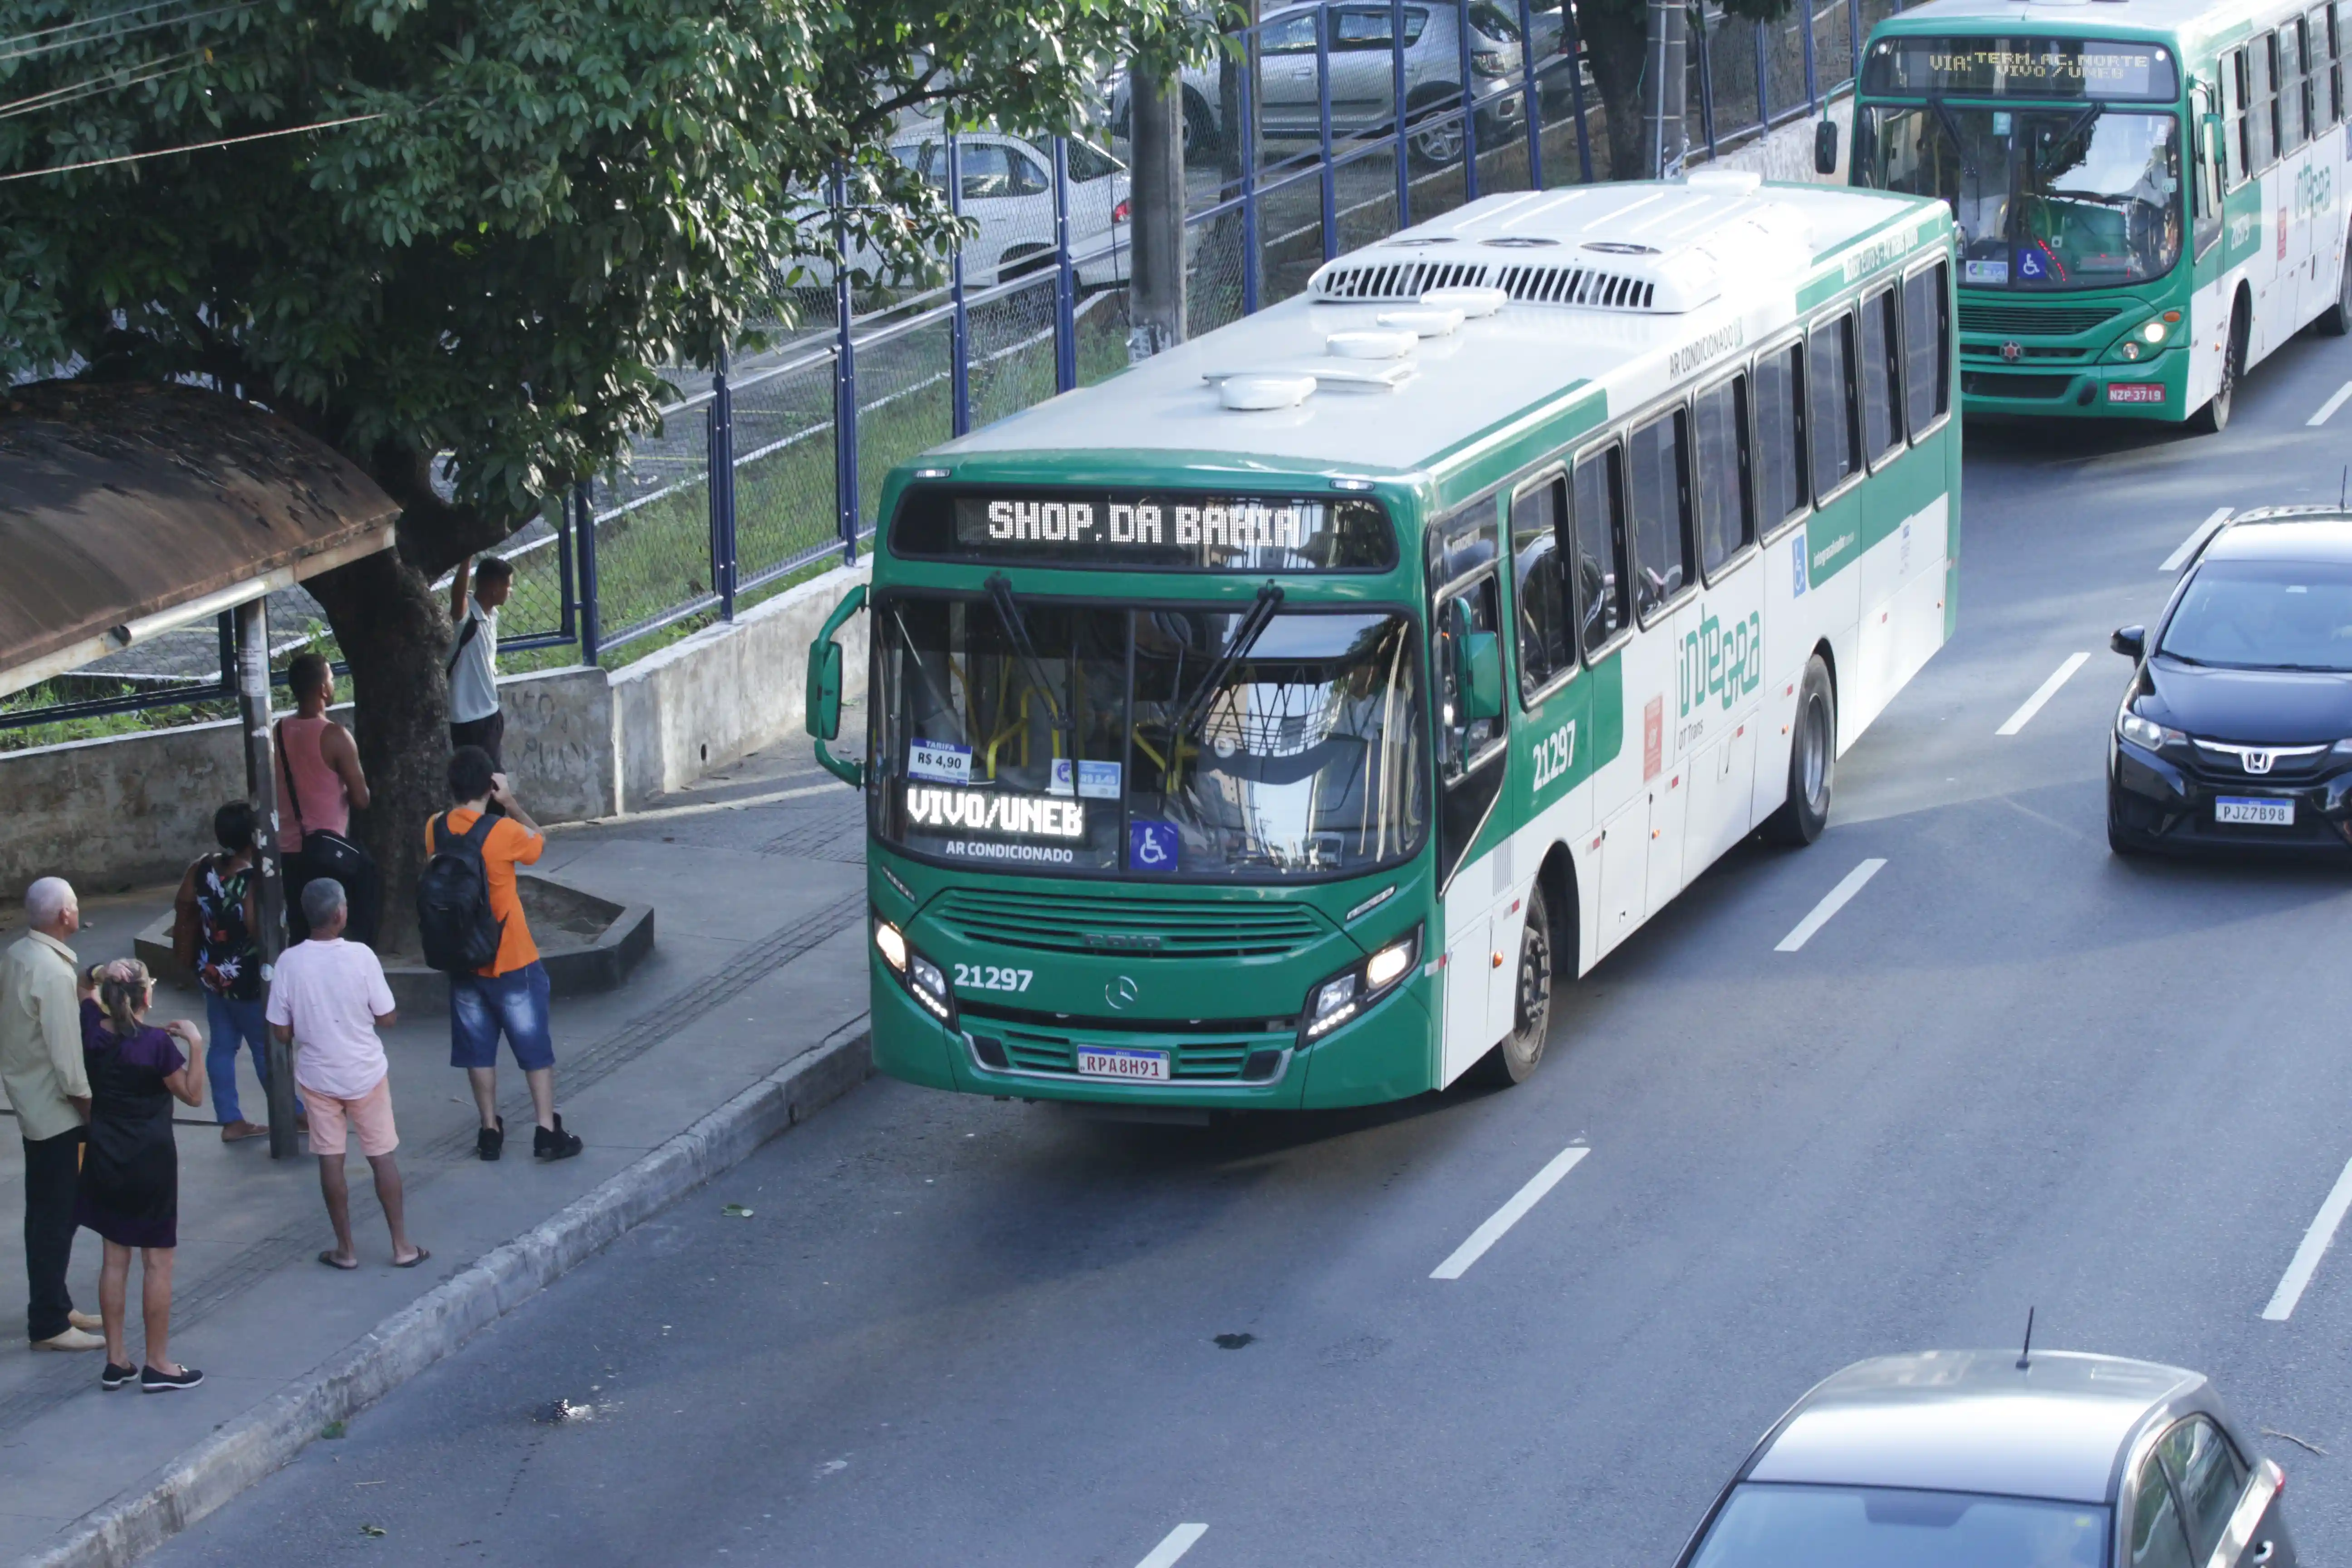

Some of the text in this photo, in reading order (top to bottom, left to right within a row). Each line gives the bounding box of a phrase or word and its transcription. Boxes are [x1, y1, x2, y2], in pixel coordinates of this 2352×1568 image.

[1669, 324, 1733, 381] AR CONDICIONADO
[926, 740, 955, 752] TARIFA
[1533, 718, 1576, 792] 21297
[917, 752, 961, 769] R$ 4,90
[2224, 806, 2285, 821] PJZ7B98
[946, 840, 1073, 862] AR CONDICIONADO
[954, 963, 1034, 992] 21297
[1087, 1056, 1159, 1077] RPA8H91
